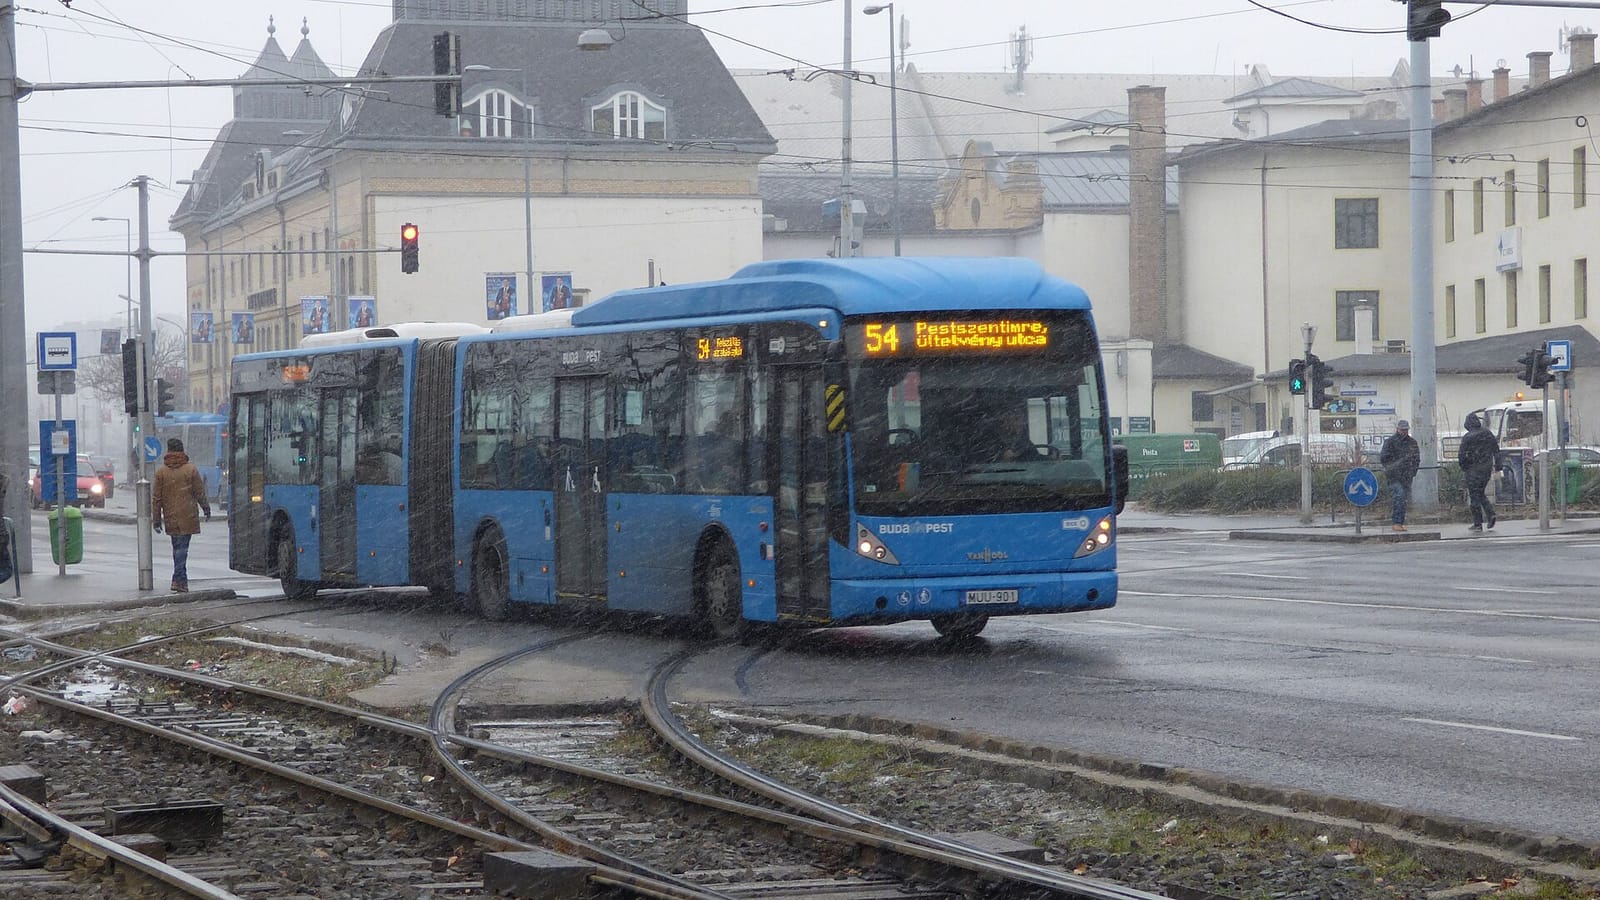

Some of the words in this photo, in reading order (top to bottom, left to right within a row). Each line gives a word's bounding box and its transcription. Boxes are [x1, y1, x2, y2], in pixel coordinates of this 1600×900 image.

[916, 320, 1048, 335] Pestszentimre,
[866, 324, 898, 352] 54
[1006, 333, 1047, 345] utca
[698, 338, 710, 359] 54
[968, 591, 1015, 603] MUU-901
